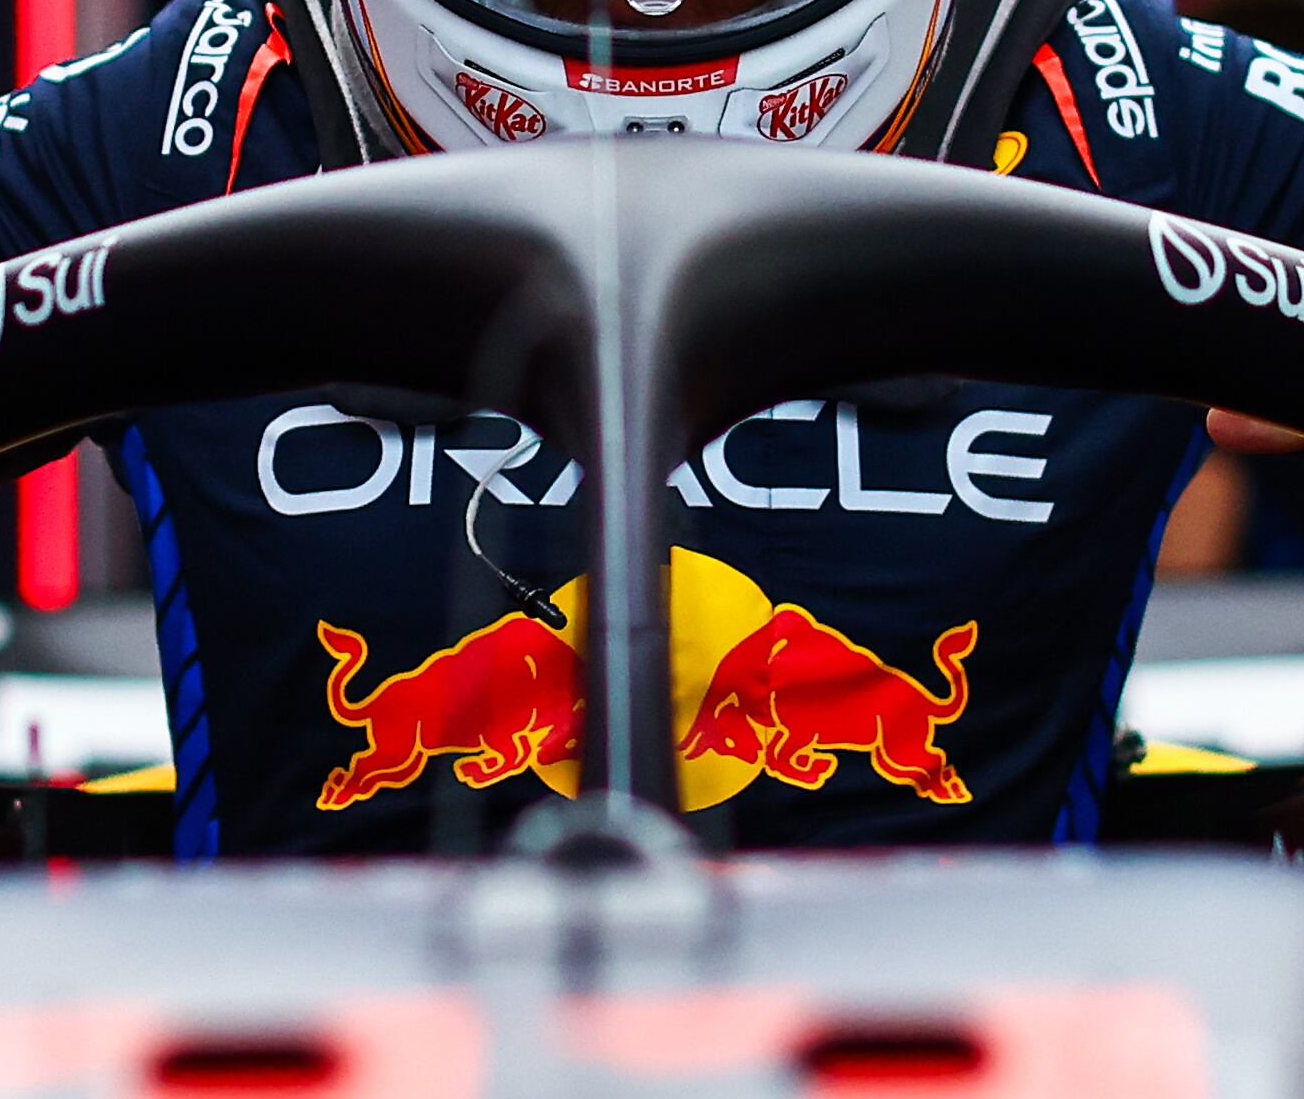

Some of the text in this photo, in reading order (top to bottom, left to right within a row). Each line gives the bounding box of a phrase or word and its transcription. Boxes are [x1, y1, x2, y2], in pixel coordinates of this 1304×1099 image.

[605, 69, 726, 93] BANORTE
[769, 77, 845, 139] KitKat
[465, 85, 542, 141] KitKat
